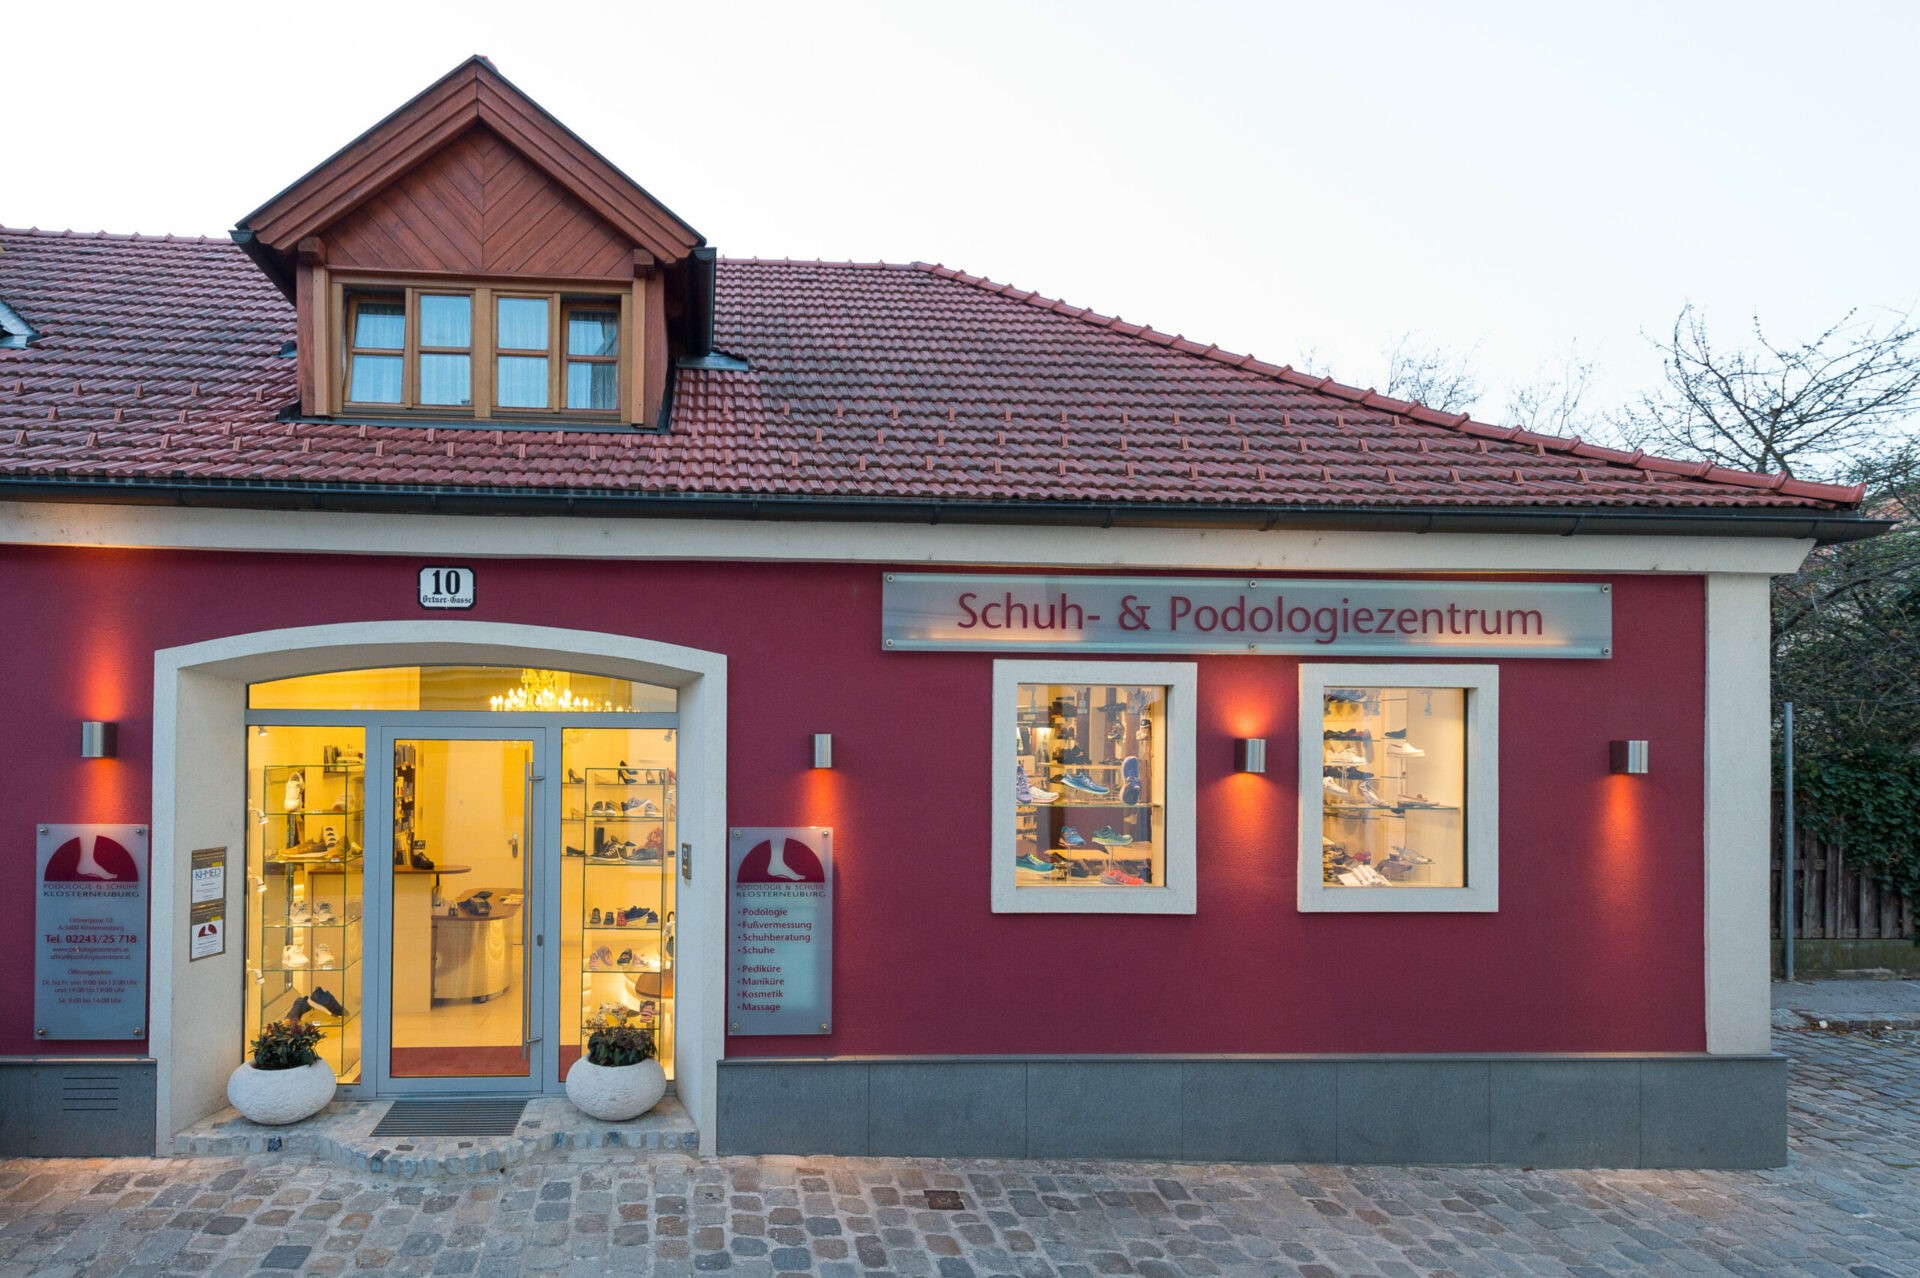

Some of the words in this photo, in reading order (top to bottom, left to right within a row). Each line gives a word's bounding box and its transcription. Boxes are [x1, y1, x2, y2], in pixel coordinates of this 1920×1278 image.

[432, 569, 461, 595] 10
[957, 591, 1101, 630] Schuh-
[1118, 595, 1151, 631] &
[1170, 595, 1544, 645] Podologiezentrum
[43, 890, 139, 898] KLOSTERNEUBURG
[742, 908, 788, 917] Podologie
[742, 921, 812, 930] Fußvermessung
[118, 935, 137, 944] 718
[742, 933, 811, 943] Schuhberatung
[742, 946, 775, 954] Schuhe
[742, 964, 782, 973] Pediküre
[742, 978, 785, 986] Maniküre
[742, 990, 784, 998] Kosmetik
[742, 1003, 781, 1013] Massage
